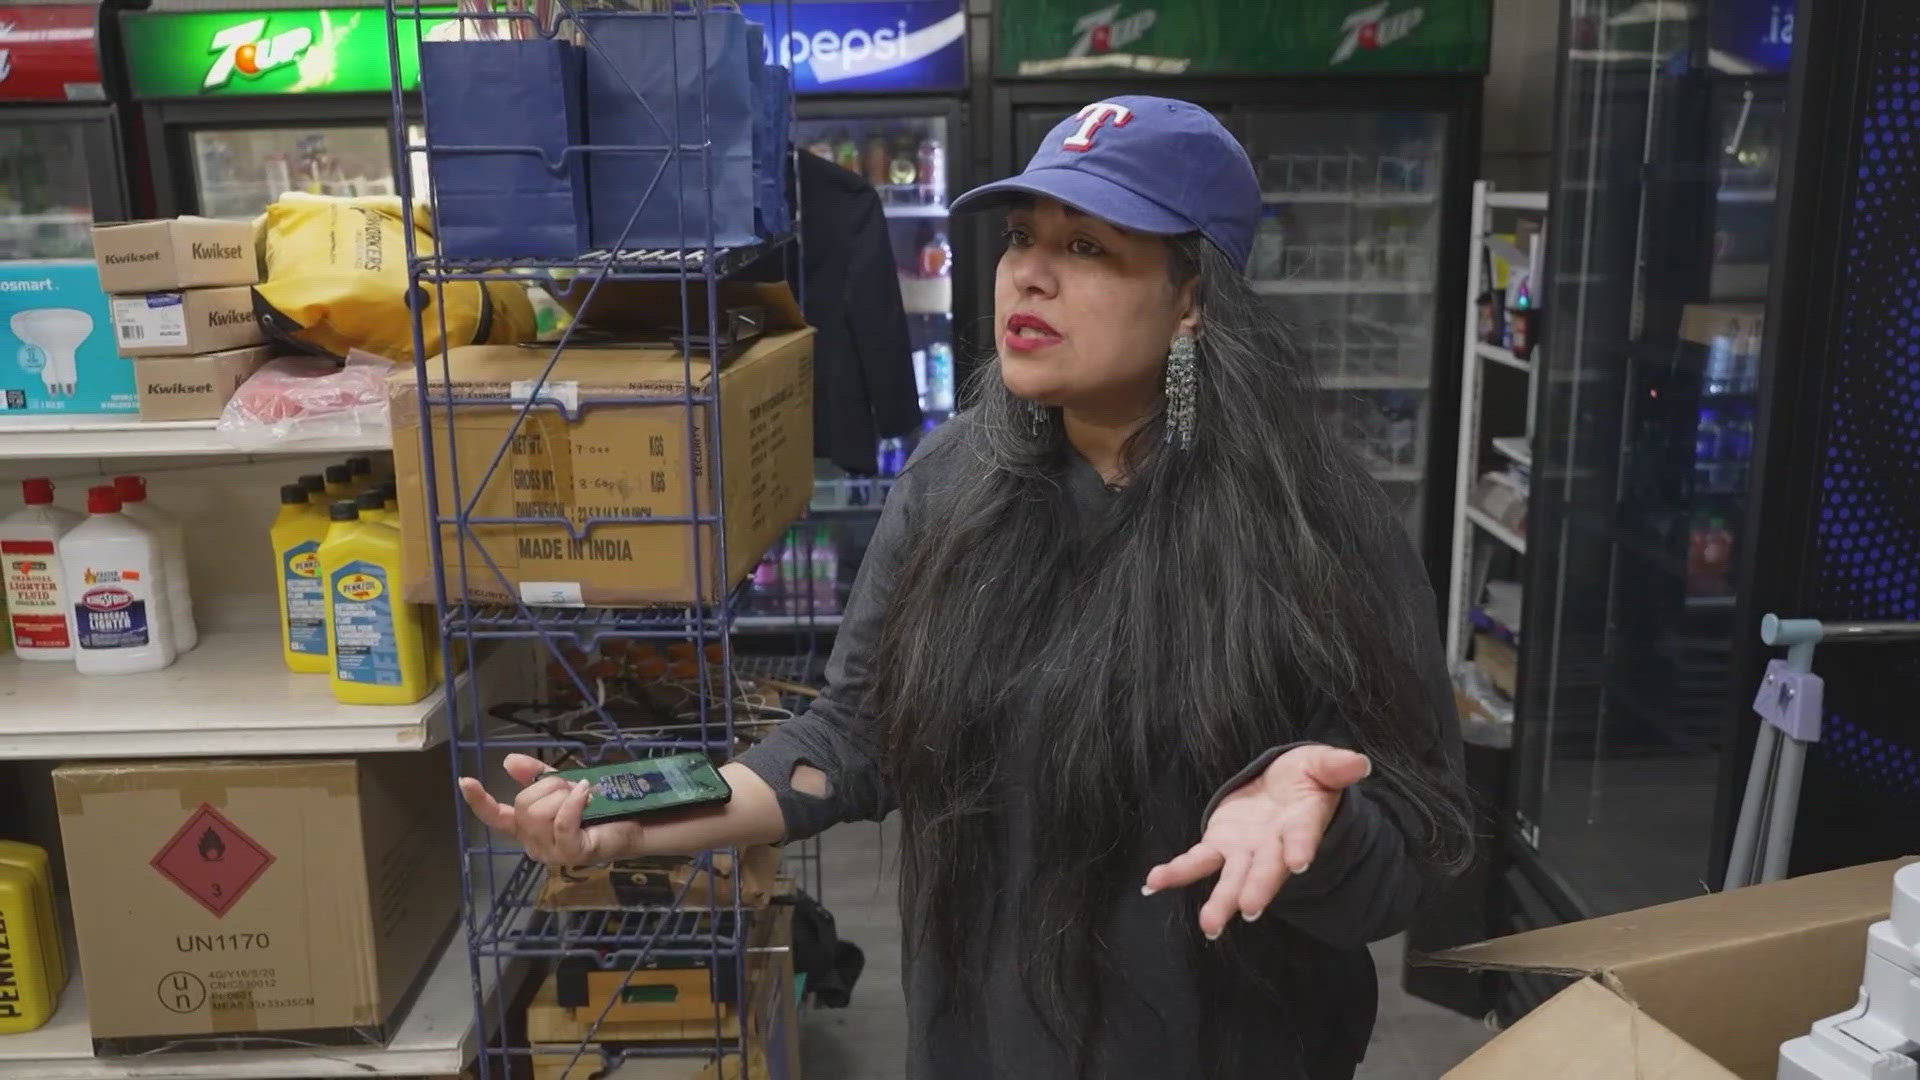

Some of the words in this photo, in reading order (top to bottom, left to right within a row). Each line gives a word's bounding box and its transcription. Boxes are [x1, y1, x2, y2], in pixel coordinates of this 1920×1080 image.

[780, 20, 907, 72] pepsi
[1063, 103, 1134, 152] T
[105, 251, 160, 264] Kwikset
[192, 243, 243, 260] Kwikset
[148, 383, 213, 395] Kwikset
[649, 435, 664, 456] KGS
[514, 469, 541, 490] GROSS
[651, 471, 666, 492] KGS
[516, 502, 565, 518] DIMENSION
[518, 538, 563, 560] MADE
[568, 538, 584, 560] IN
[589, 538, 633, 561] INDIA
[10, 582, 57, 591] LIGHTER
[18, 591, 50, 600] FLUID
[89, 619, 132, 630] LIGHTER
[211, 883, 222, 898] 3
[176, 932, 271, 953] UN1170
